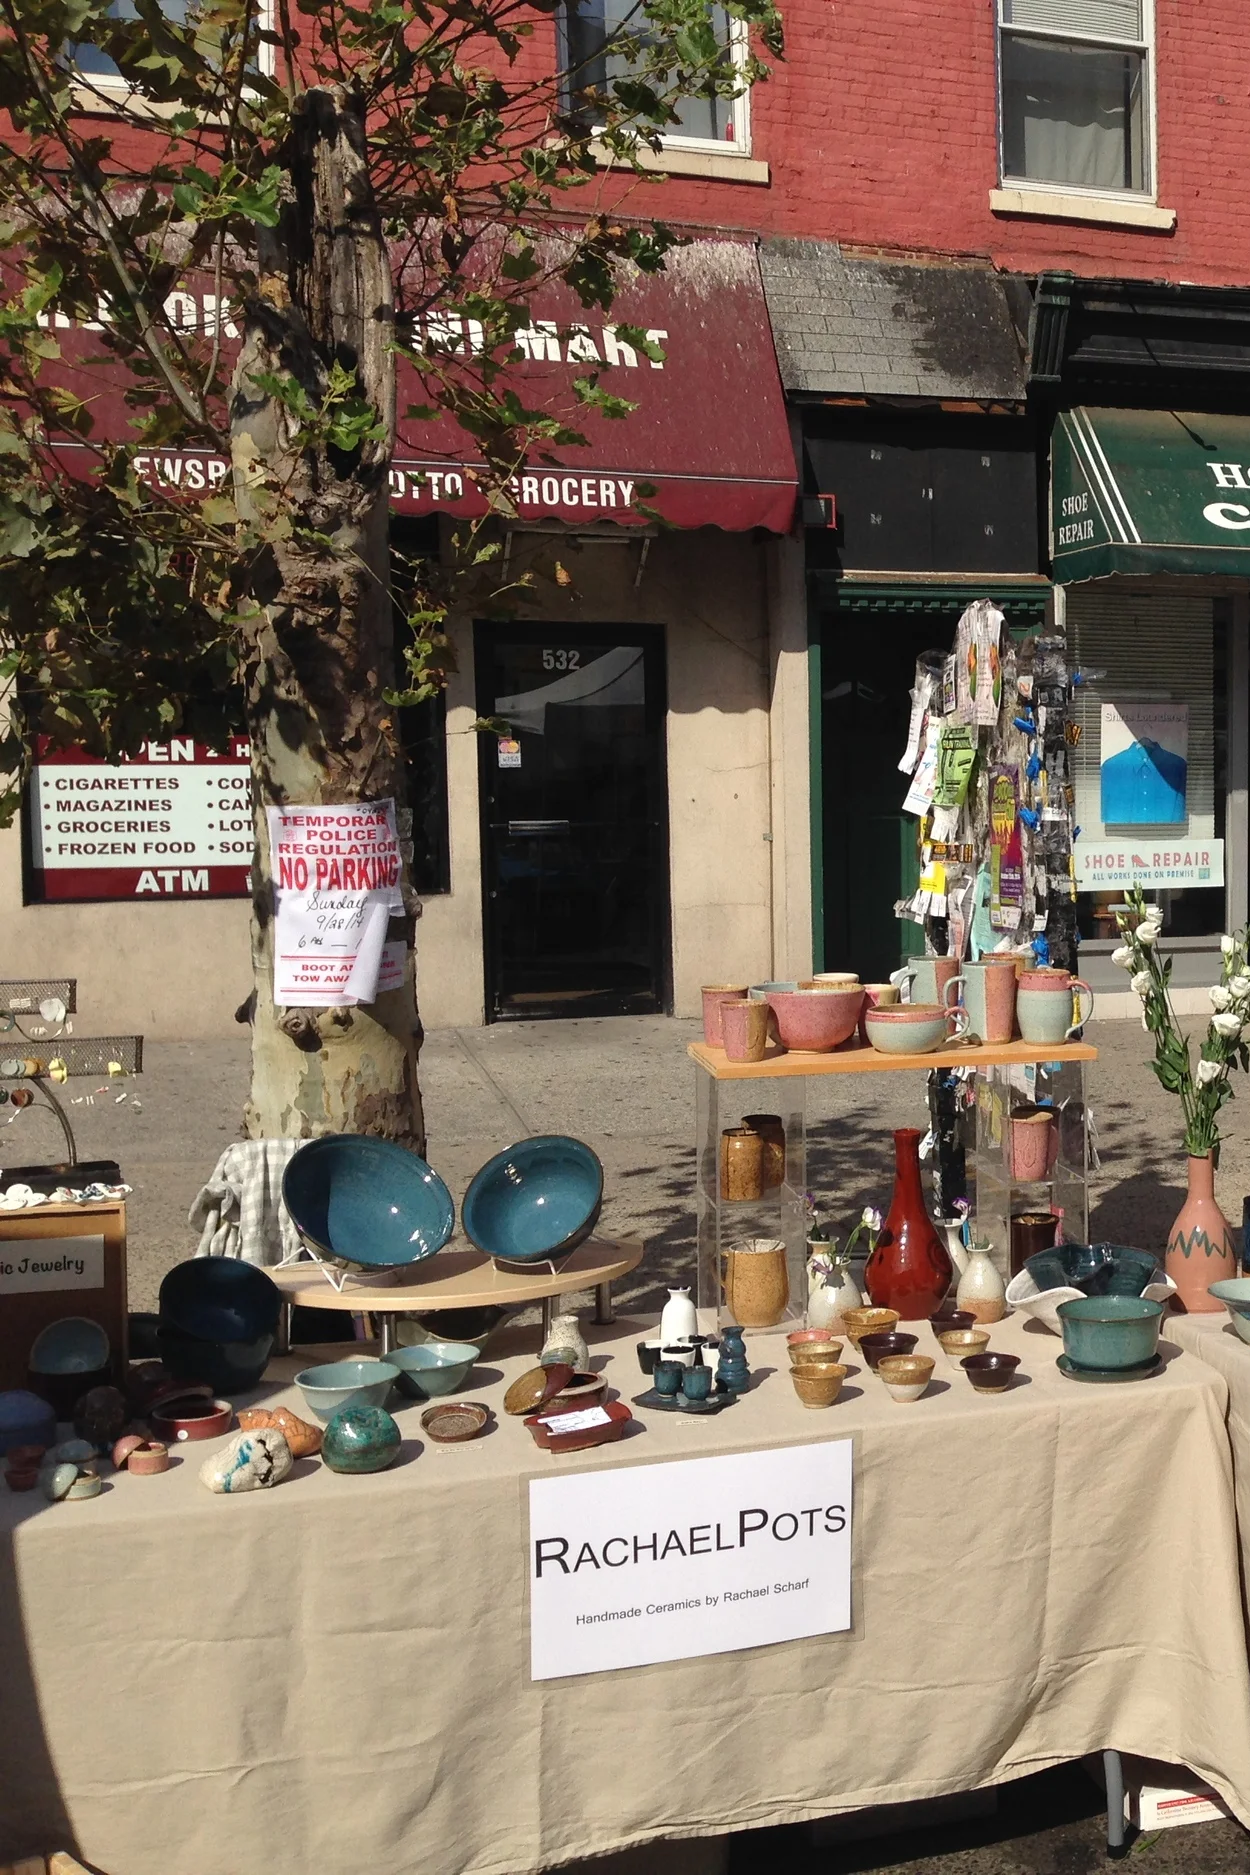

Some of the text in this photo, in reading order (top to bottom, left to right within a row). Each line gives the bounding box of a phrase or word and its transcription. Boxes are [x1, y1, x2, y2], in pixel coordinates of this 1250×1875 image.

[387, 469, 463, 501] OTTO
[1062, 492, 1088, 517] SHOE
[1059, 519, 1094, 546] REPAIR
[543, 650, 580, 670] 532
[55, 778, 180, 790] CIGARETTES
[56, 800, 172, 812] MAGAZINES
[57, 820, 253, 833] GROCERIES LOT
[278, 815, 386, 827] TEMPORAR
[306, 829, 377, 841] POLICE
[58, 841, 255, 855] FROZEN FOOD SOD
[278, 841, 397, 855] REGULATION
[1084, 852, 1210, 869] SHOE REPAIR
[135, 869, 209, 893] ATM
[279, 854, 399, 891] NO PARKING
[1092, 872, 1105, 881] ALL
[1107, 871, 1131, 880] WORKS
[1133, 871, 1152, 879] DONE
[1154, 870, 1164, 879] ON
[306, 890, 368, 918] Sunday
[316, 913, 364, 932] 9/28/14
[301, 964, 336, 972] BOOT
[292, 974, 320, 982] TOW
[18, 1255, 85, 1275] Jewelry
[576, 1578, 810, 1626] Handmade Ceramics by Rachael Scharf
